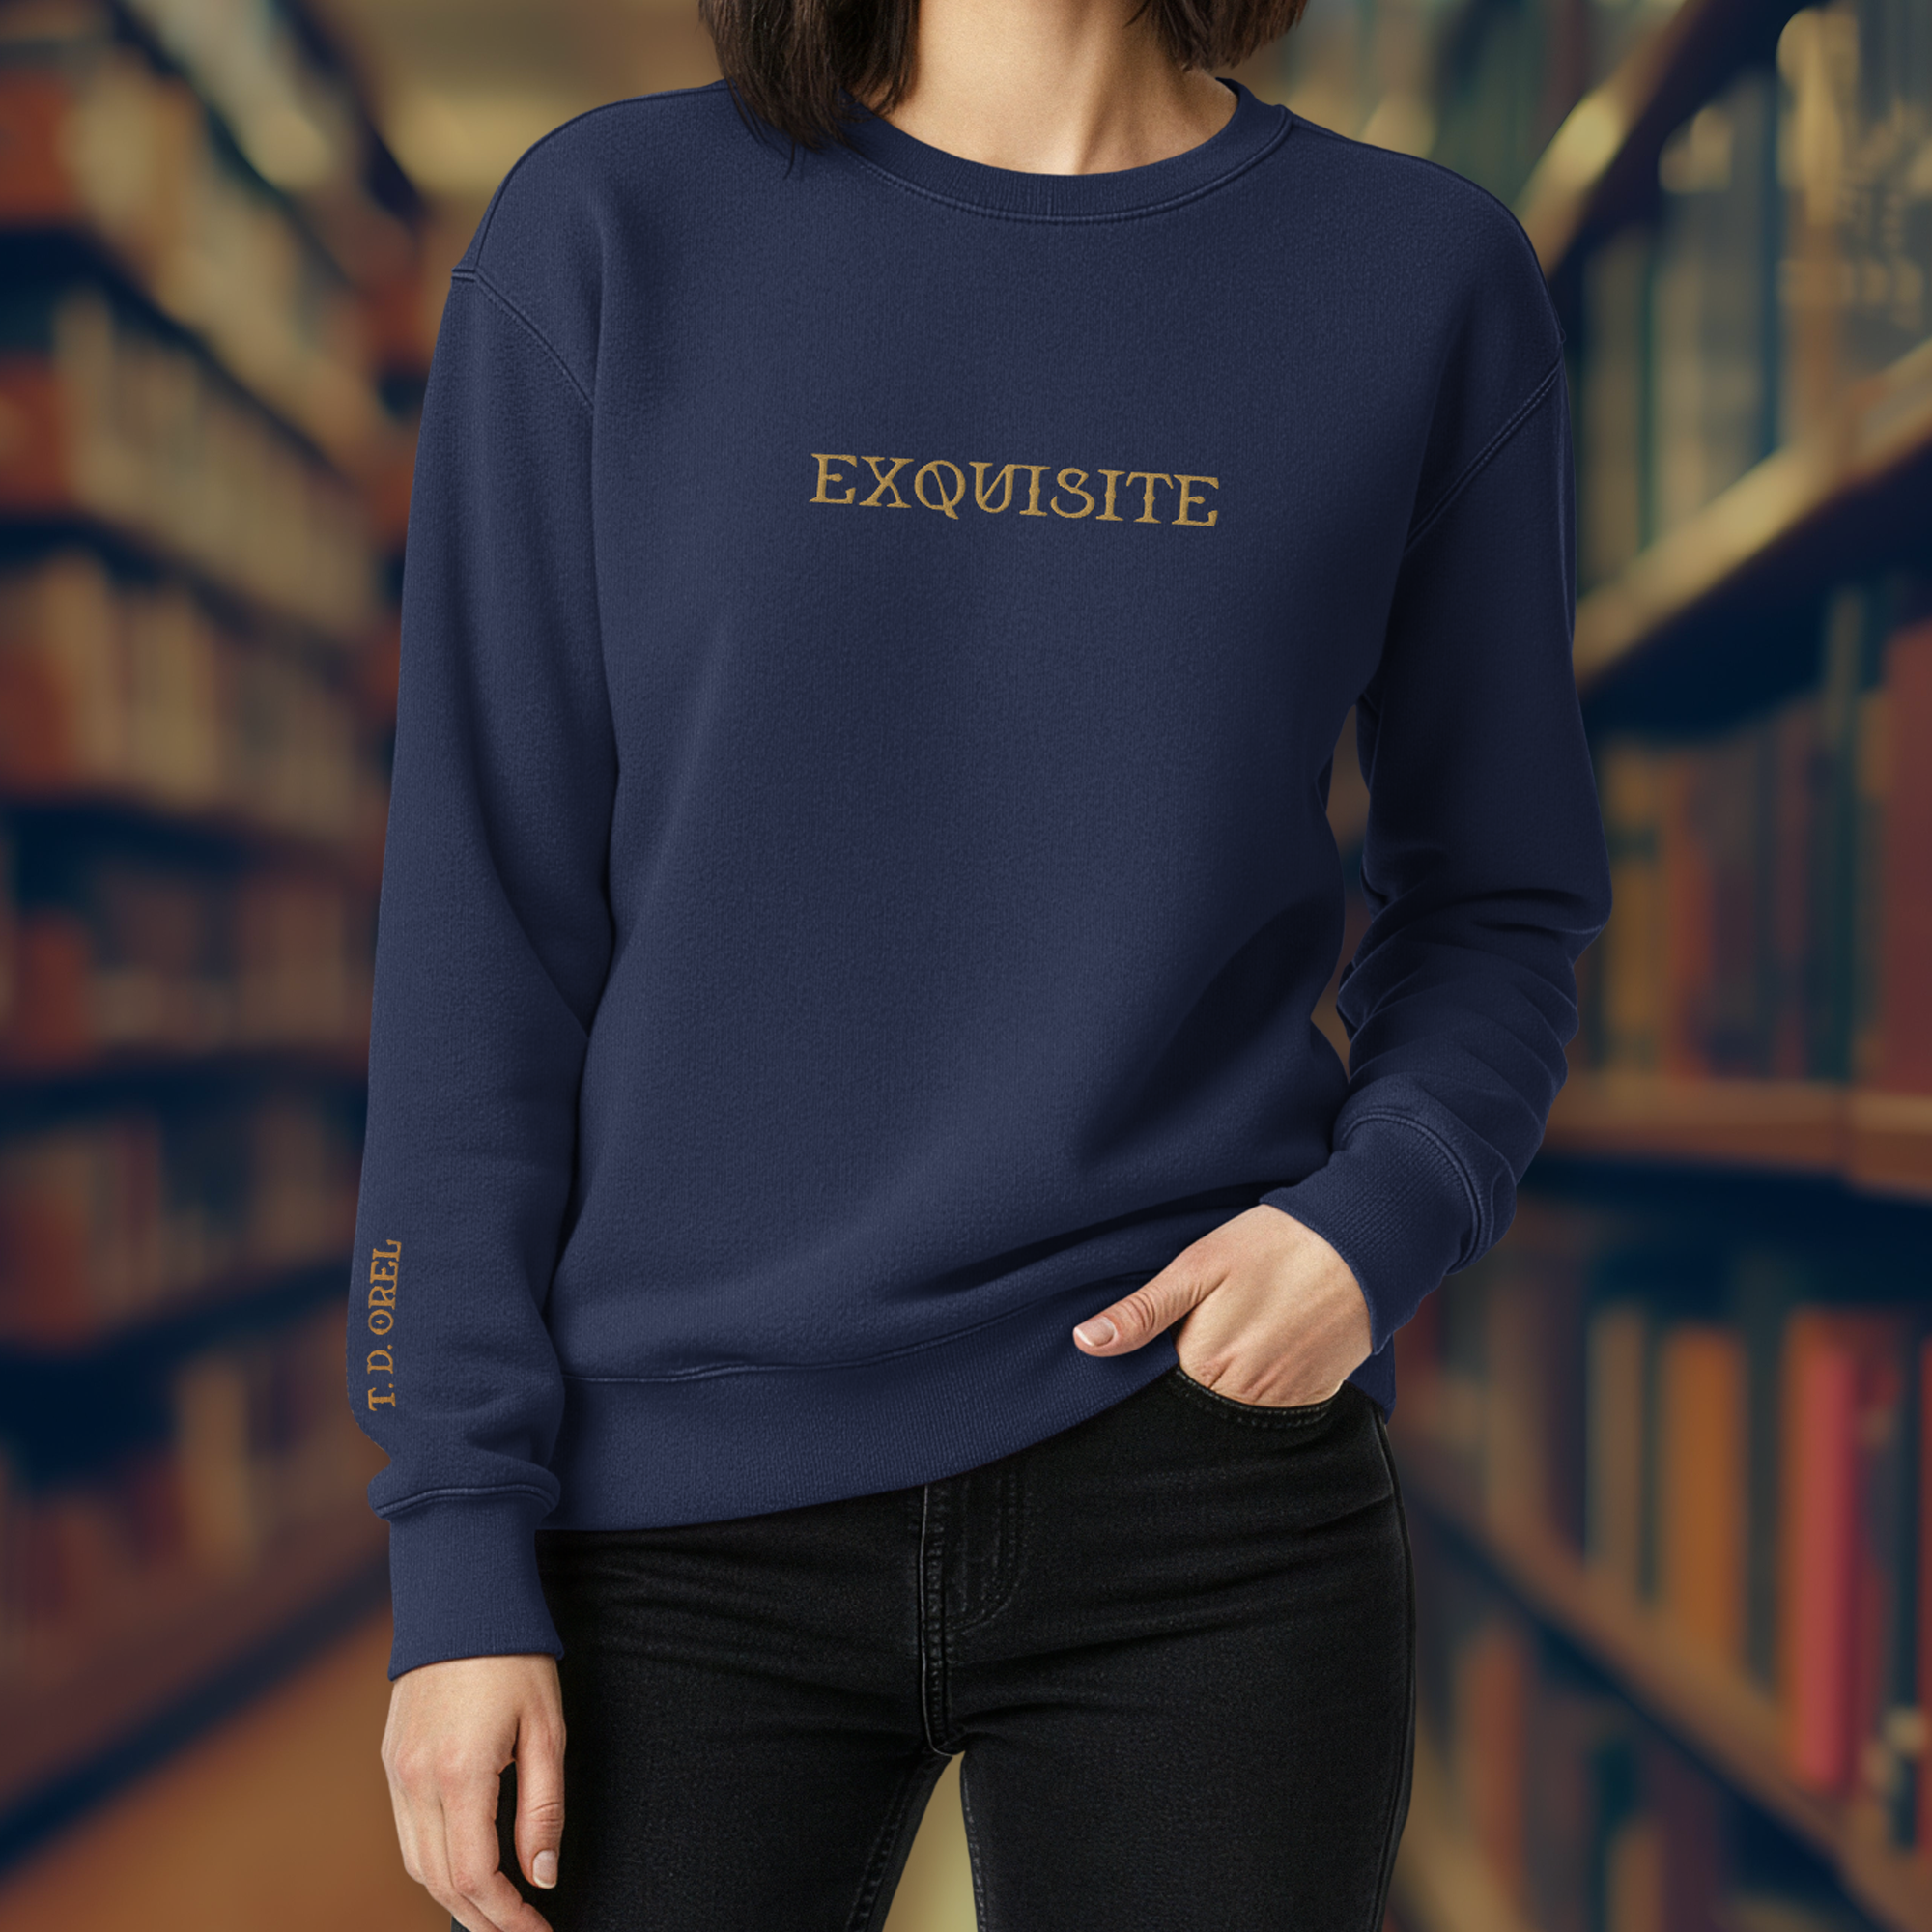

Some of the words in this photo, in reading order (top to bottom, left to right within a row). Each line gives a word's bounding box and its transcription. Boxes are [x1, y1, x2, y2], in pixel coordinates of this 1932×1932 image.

[810, 453, 1219, 526] EXQUISITE
[368, 1239, 402, 1335] OREL
[367, 1344, 394, 1374] D.
[368, 1382, 396, 1412] T.
